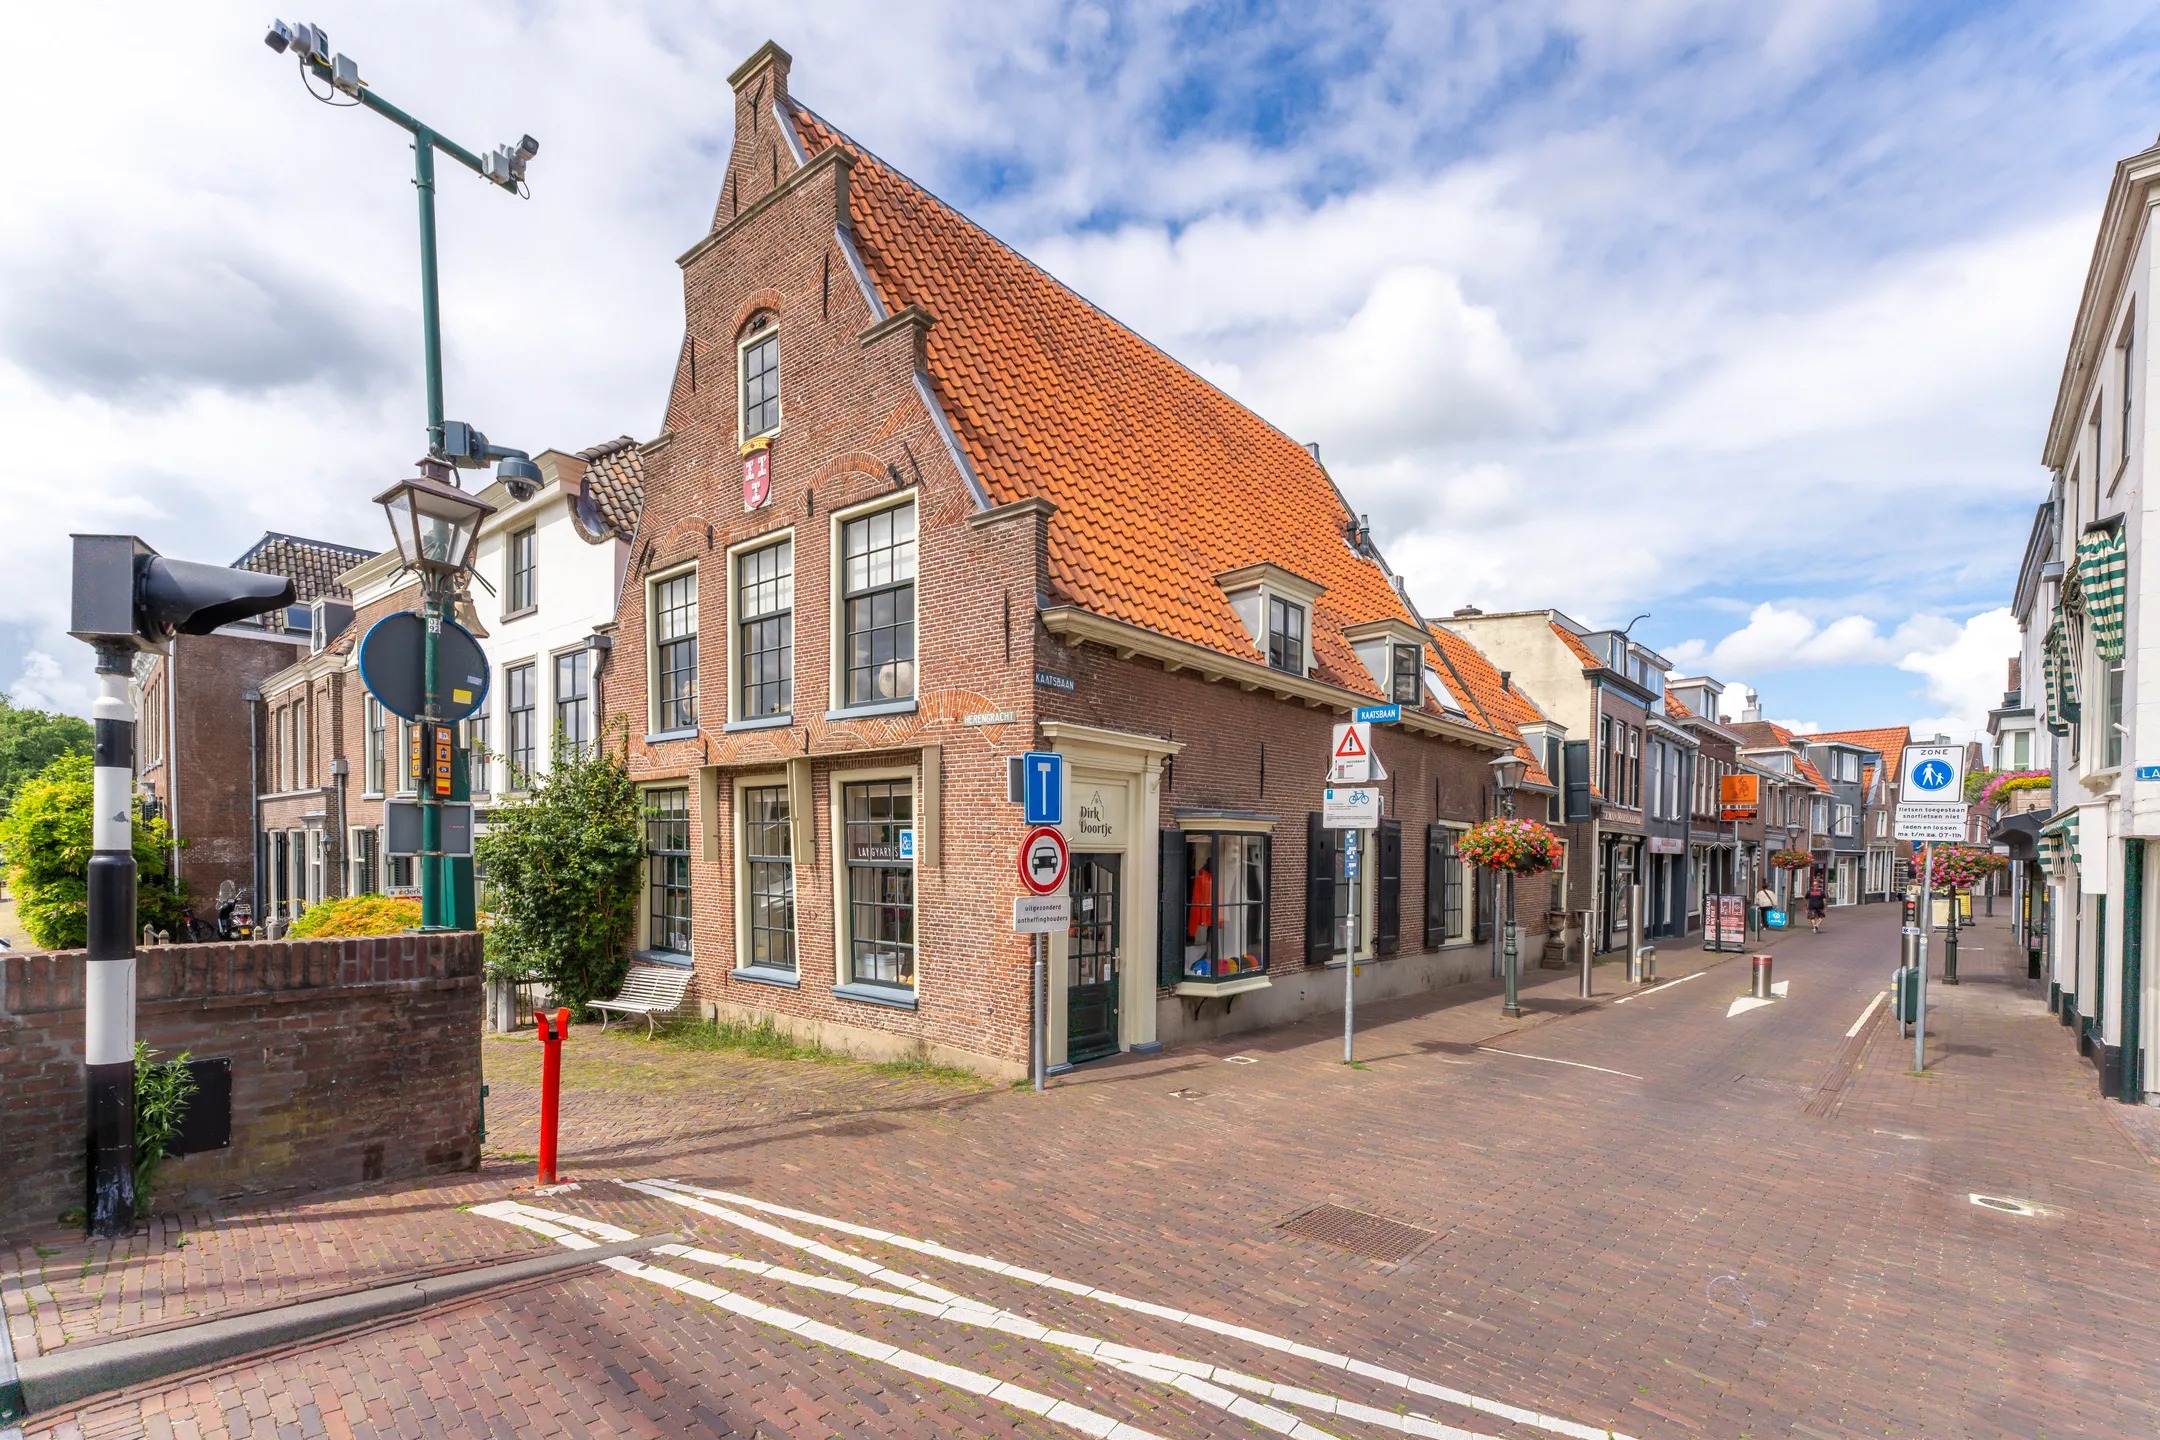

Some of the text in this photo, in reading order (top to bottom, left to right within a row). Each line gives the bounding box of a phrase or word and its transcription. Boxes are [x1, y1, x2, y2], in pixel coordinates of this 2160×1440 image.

[1035, 672, 1074, 690] KAATSBAAN
[964, 711, 1014, 725] HERENGRACHT
[1361, 709, 1396, 720] KAATSBAAN
[1080, 805, 1100, 822] Dirk
[1024, 904, 1062, 912] uitgezonderd
